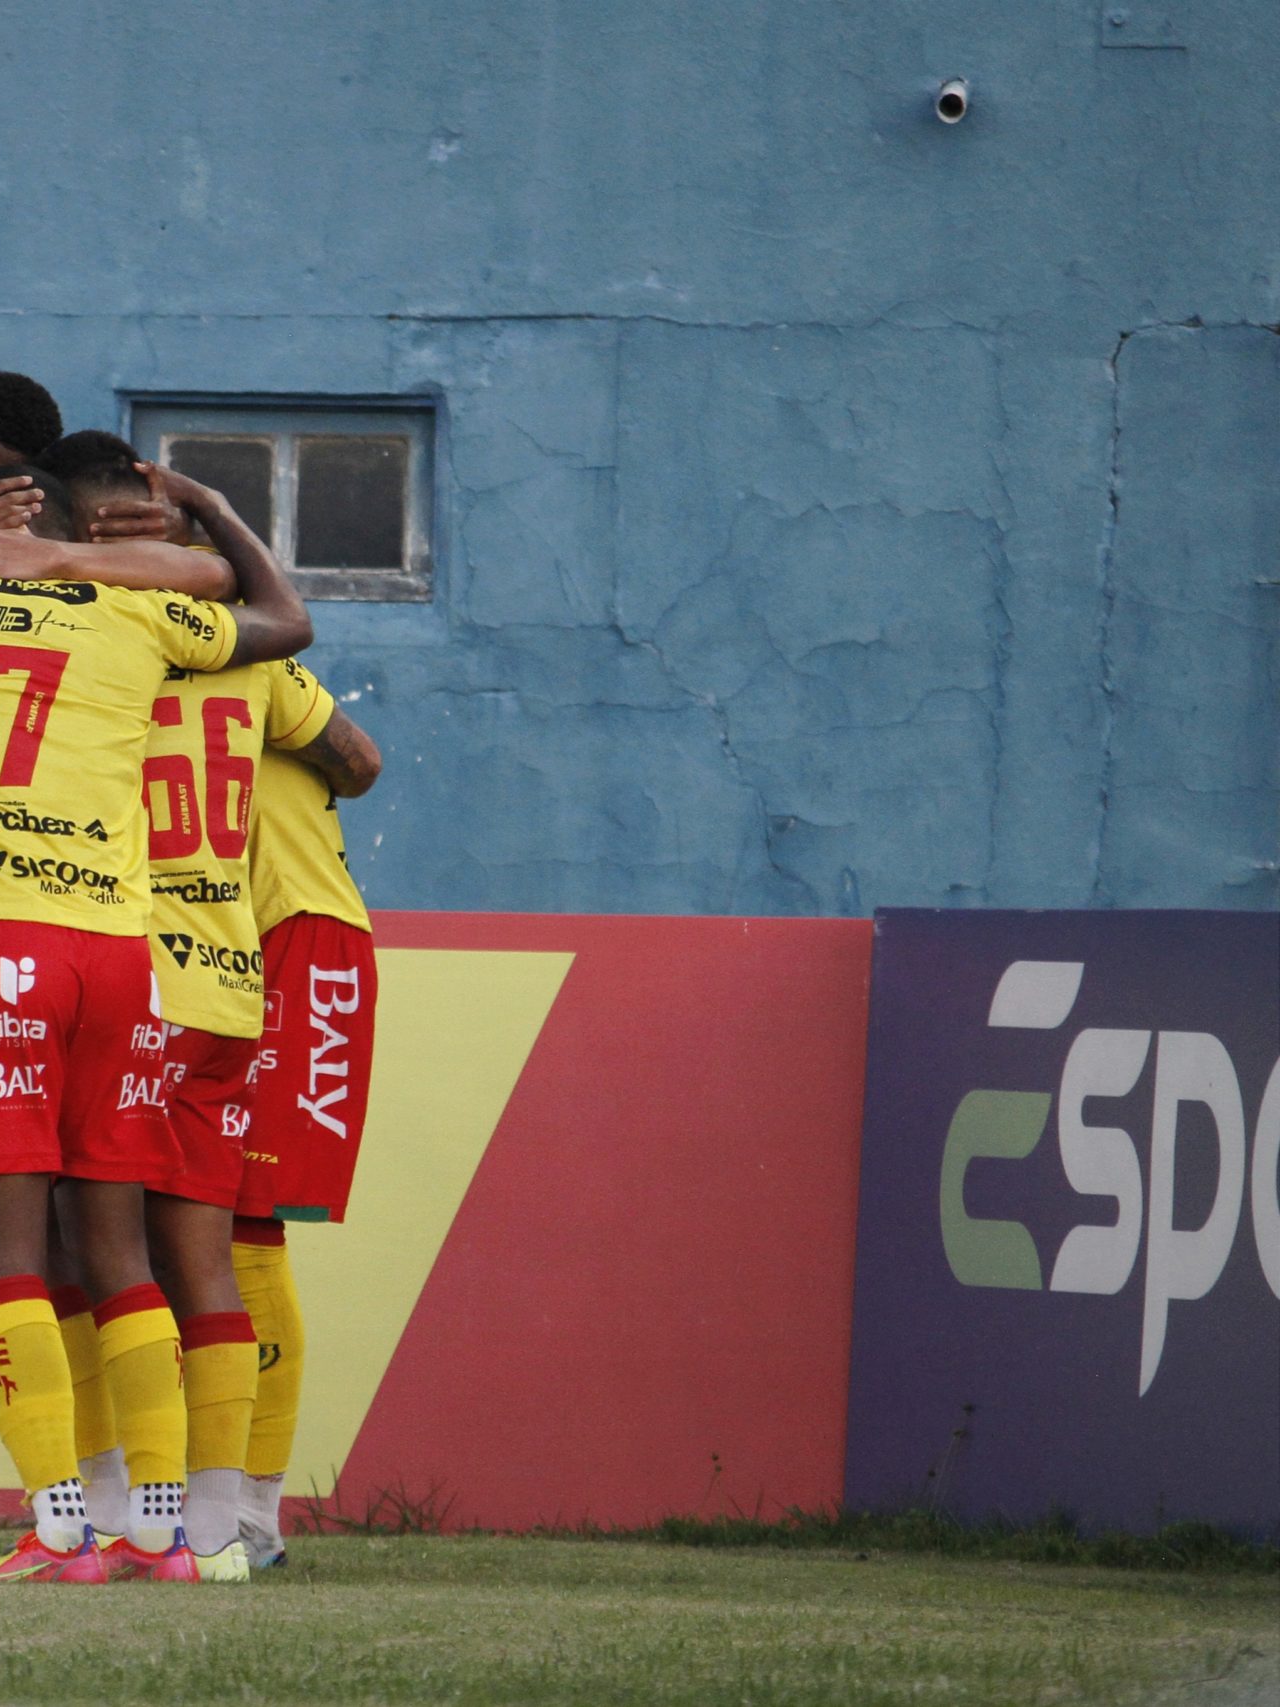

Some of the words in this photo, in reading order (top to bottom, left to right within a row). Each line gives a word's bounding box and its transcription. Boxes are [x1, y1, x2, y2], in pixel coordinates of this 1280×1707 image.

[197, 943, 264, 975] SICOO
[297, 964, 360, 1139] BALY
[116, 1072, 169, 1118] BAL
